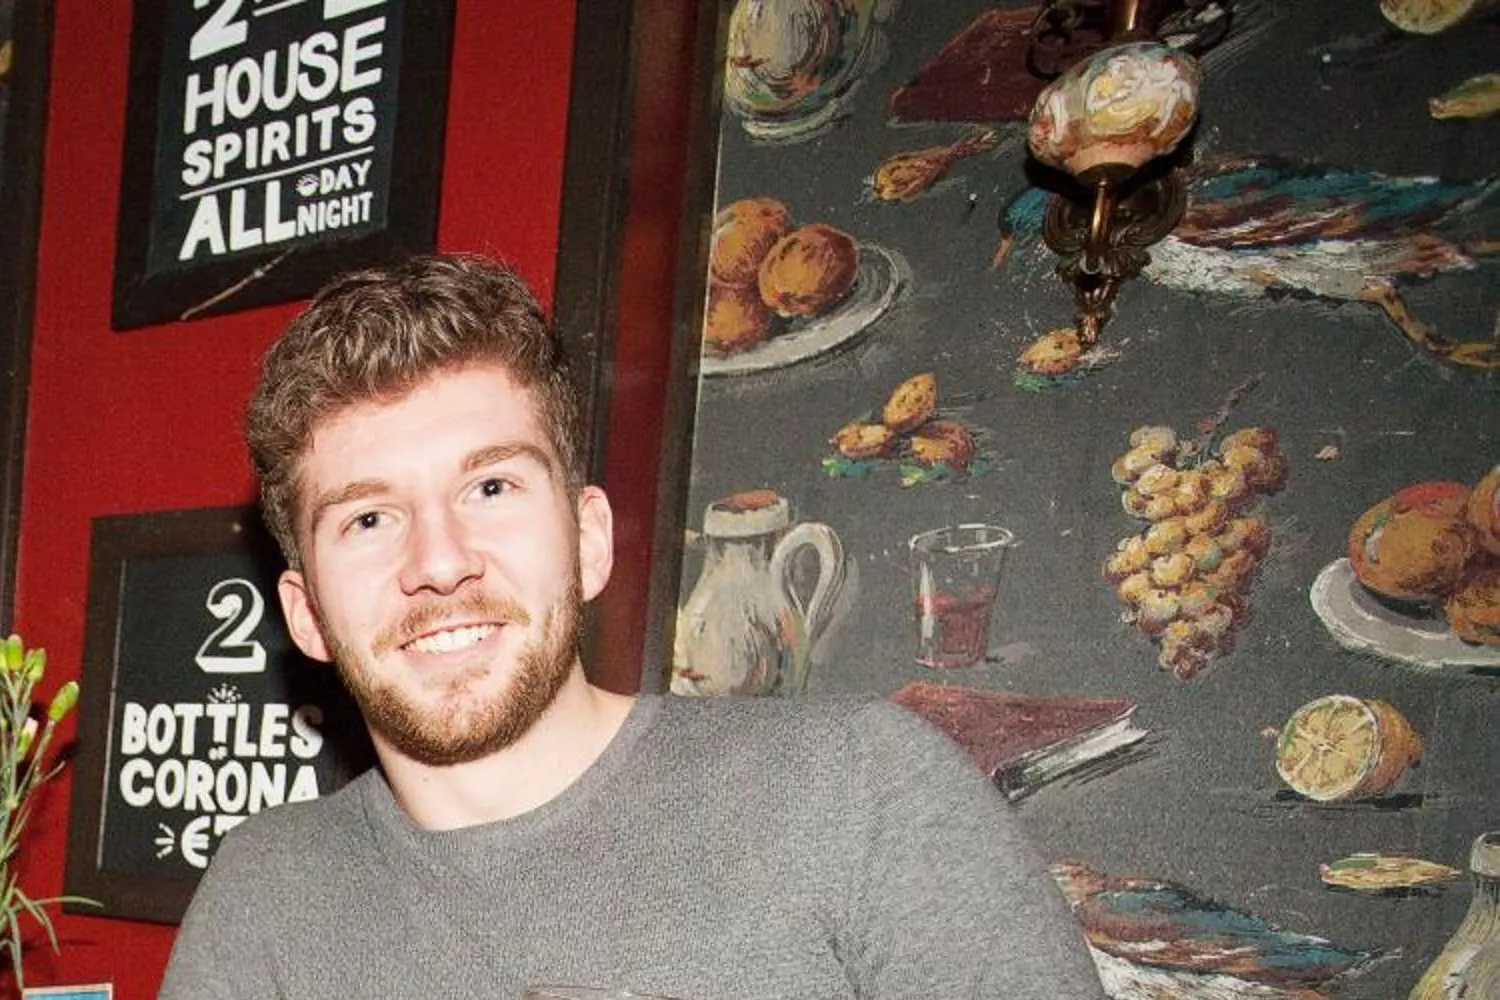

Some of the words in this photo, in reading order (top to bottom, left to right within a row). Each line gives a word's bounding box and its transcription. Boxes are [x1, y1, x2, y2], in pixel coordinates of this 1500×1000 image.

[189, 0, 248, 61] 2
[184, 16, 386, 134] HOUSE
[181, 97, 377, 186] SPIRITS
[320, 159, 372, 195] DAY
[179, 180, 297, 261] ALL
[297, 191, 373, 236] NIGHT
[194, 578, 267, 673] 2
[121, 702, 324, 759] BOTTLES
[119, 757, 320, 815] CORONA
